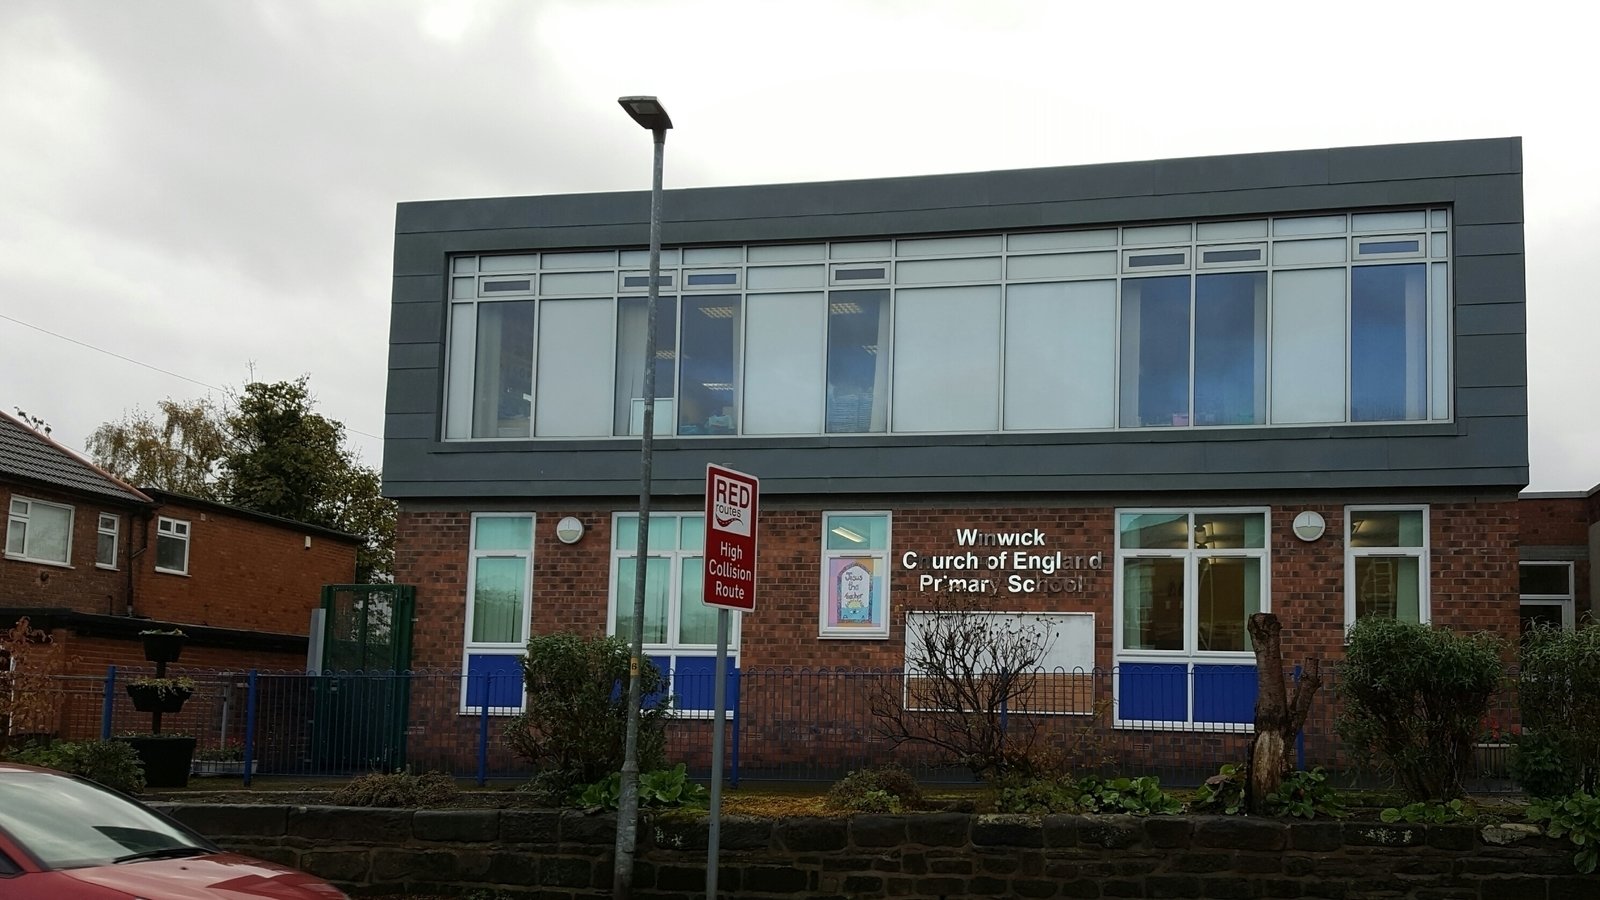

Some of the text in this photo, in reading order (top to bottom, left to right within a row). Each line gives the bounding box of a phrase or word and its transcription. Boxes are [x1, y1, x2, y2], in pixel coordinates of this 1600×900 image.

[716, 479, 750, 508] RED
[715, 503, 742, 518] routes
[956, 528, 1046, 546] Winwick
[720, 541, 743, 561] High
[708, 559, 752, 581] Collision
[902, 551, 1102, 574] Church of England
[715, 580, 745, 600] Route
[919, 574, 1082, 596] Prmary School
